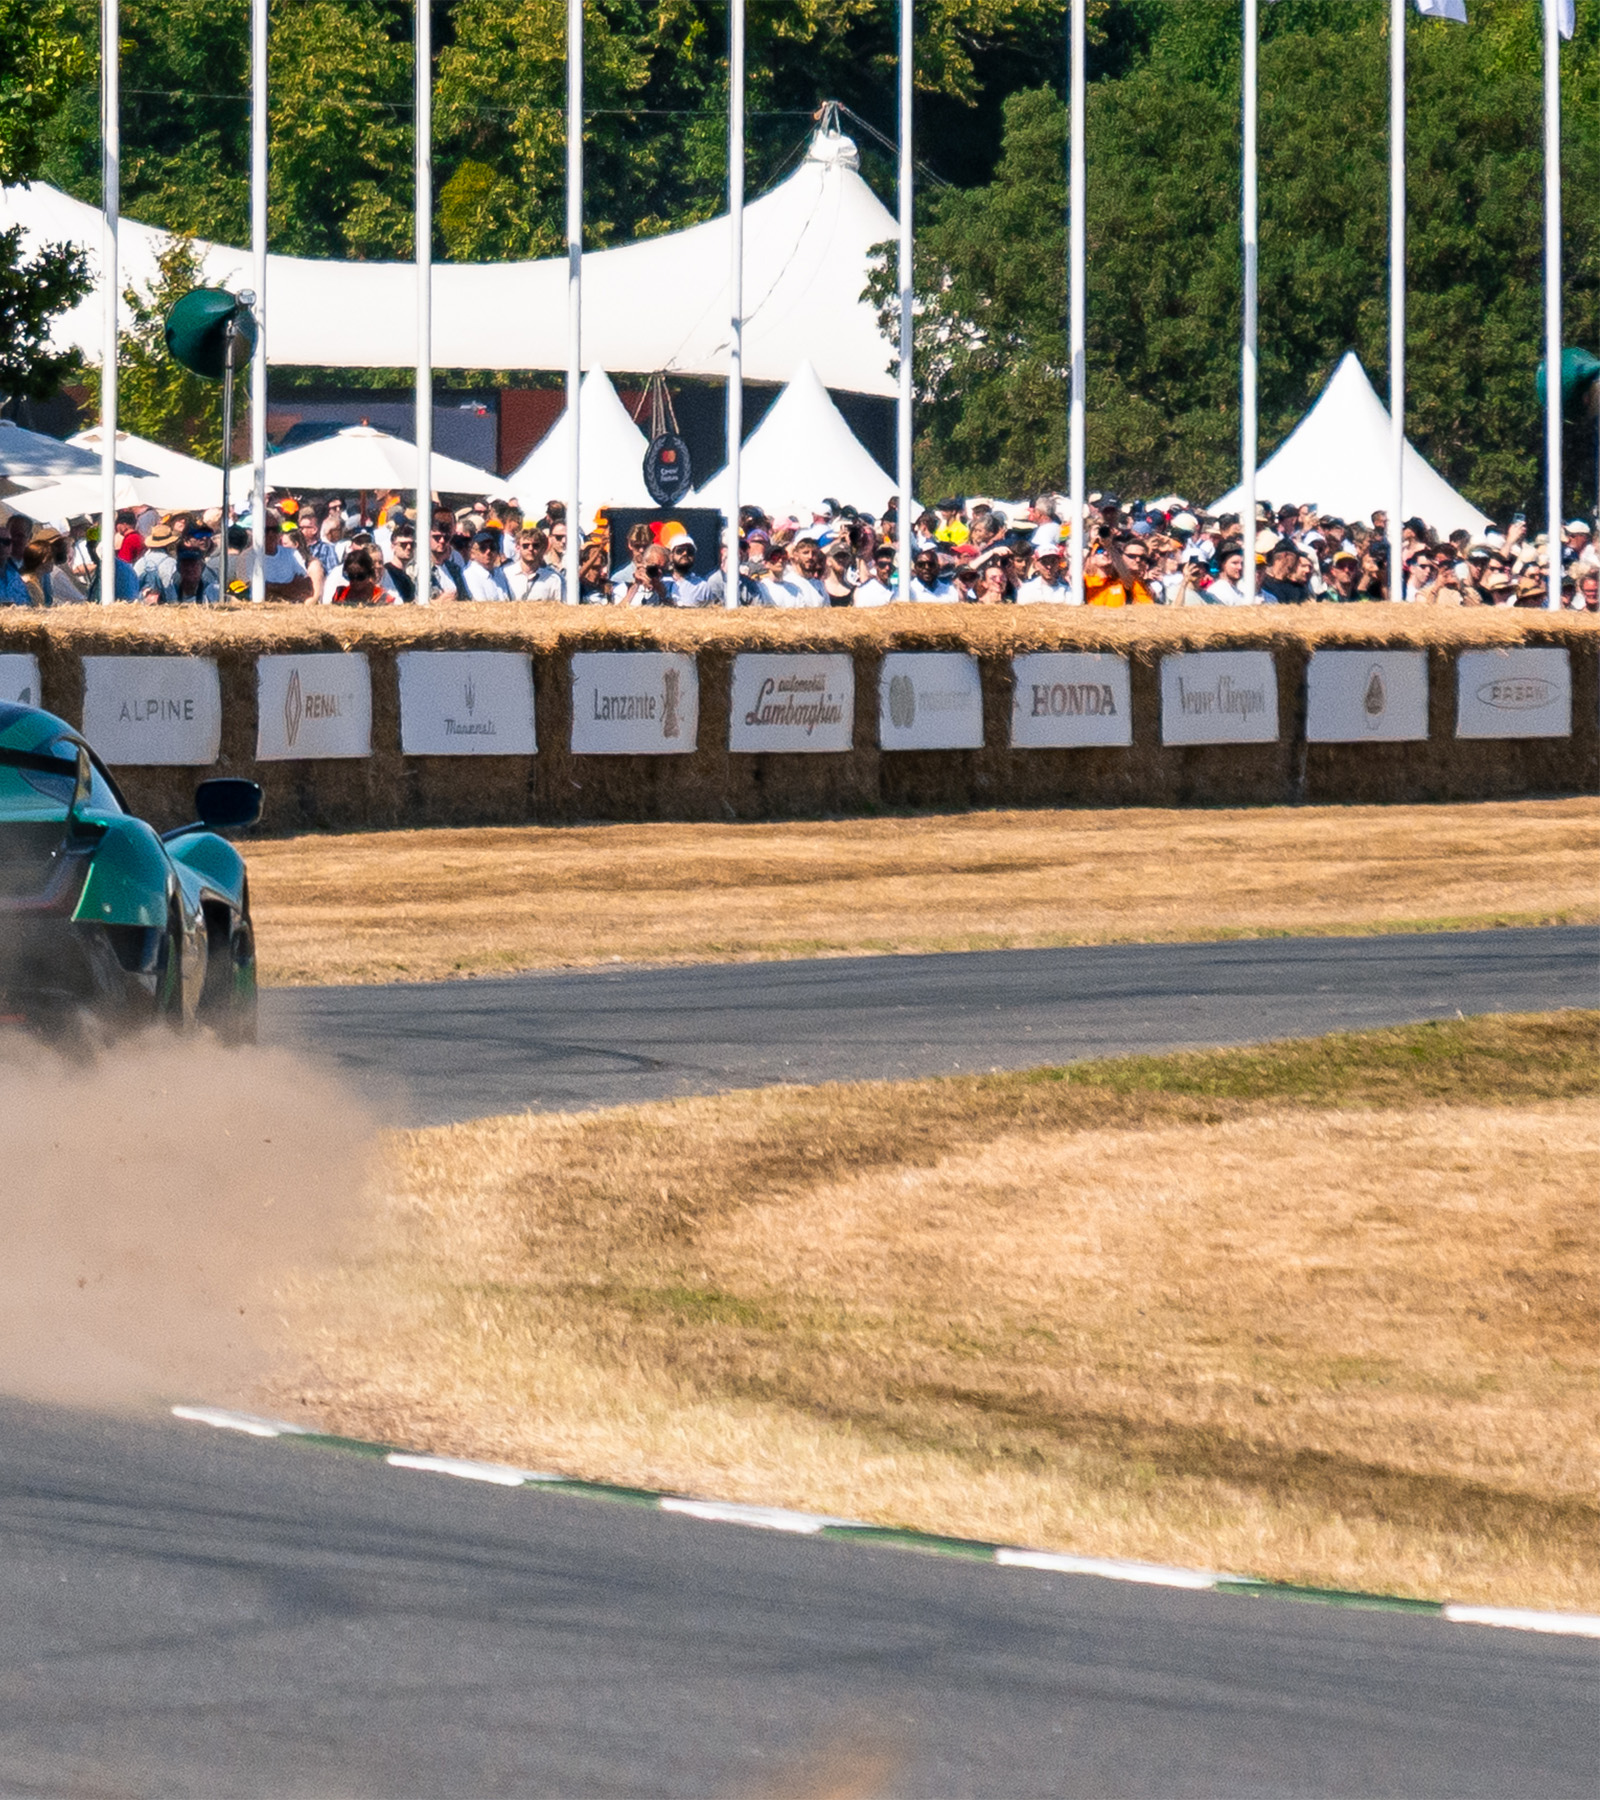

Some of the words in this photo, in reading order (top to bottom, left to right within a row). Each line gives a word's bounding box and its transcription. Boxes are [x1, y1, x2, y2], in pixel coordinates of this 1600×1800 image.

[119, 699, 195, 721] ALPINE
[305, 694, 355, 719] RENA
[594, 688, 657, 720] Lanzante
[745, 678, 844, 736] Lamborghini
[1031, 684, 1117, 717] HONDA
